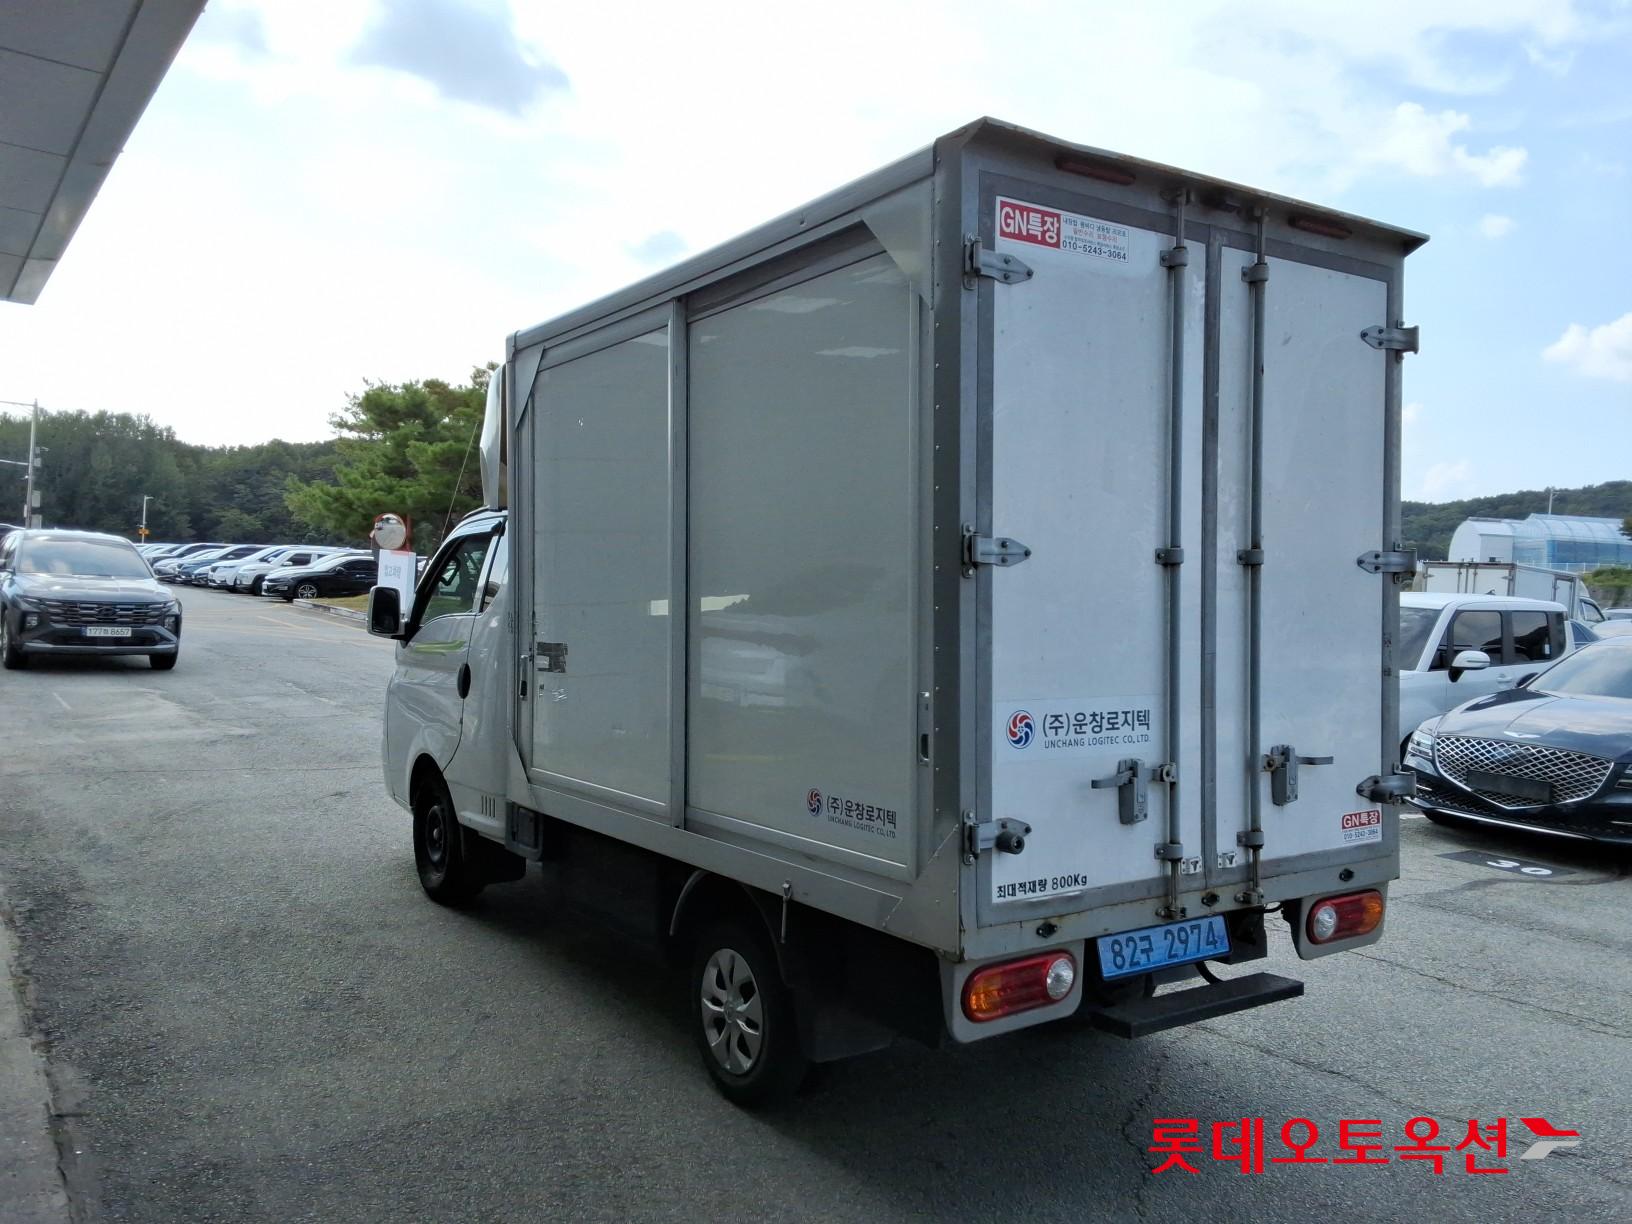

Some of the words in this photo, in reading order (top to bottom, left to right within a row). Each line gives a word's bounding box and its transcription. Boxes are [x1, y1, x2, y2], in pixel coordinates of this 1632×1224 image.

[1000, 207, 1060, 243] GN특장
[1062, 240, 1127, 261] 010-5243-3064
[1042, 709, 1151, 737] (주)운창로지텍
[1044, 737, 1085, 749] UNCHANG
[1087, 735, 1119, 746] LOGITEC
[1343, 811, 1379, 828] GN특장
[1486, 859, 1553, 875] 30
[997, 878, 1048, 899] 최대적재량
[1051, 873, 1088, 890] 800Kg
[1110, 935, 1154, 970] 82구
[1163, 921, 1218, 960] 2974
